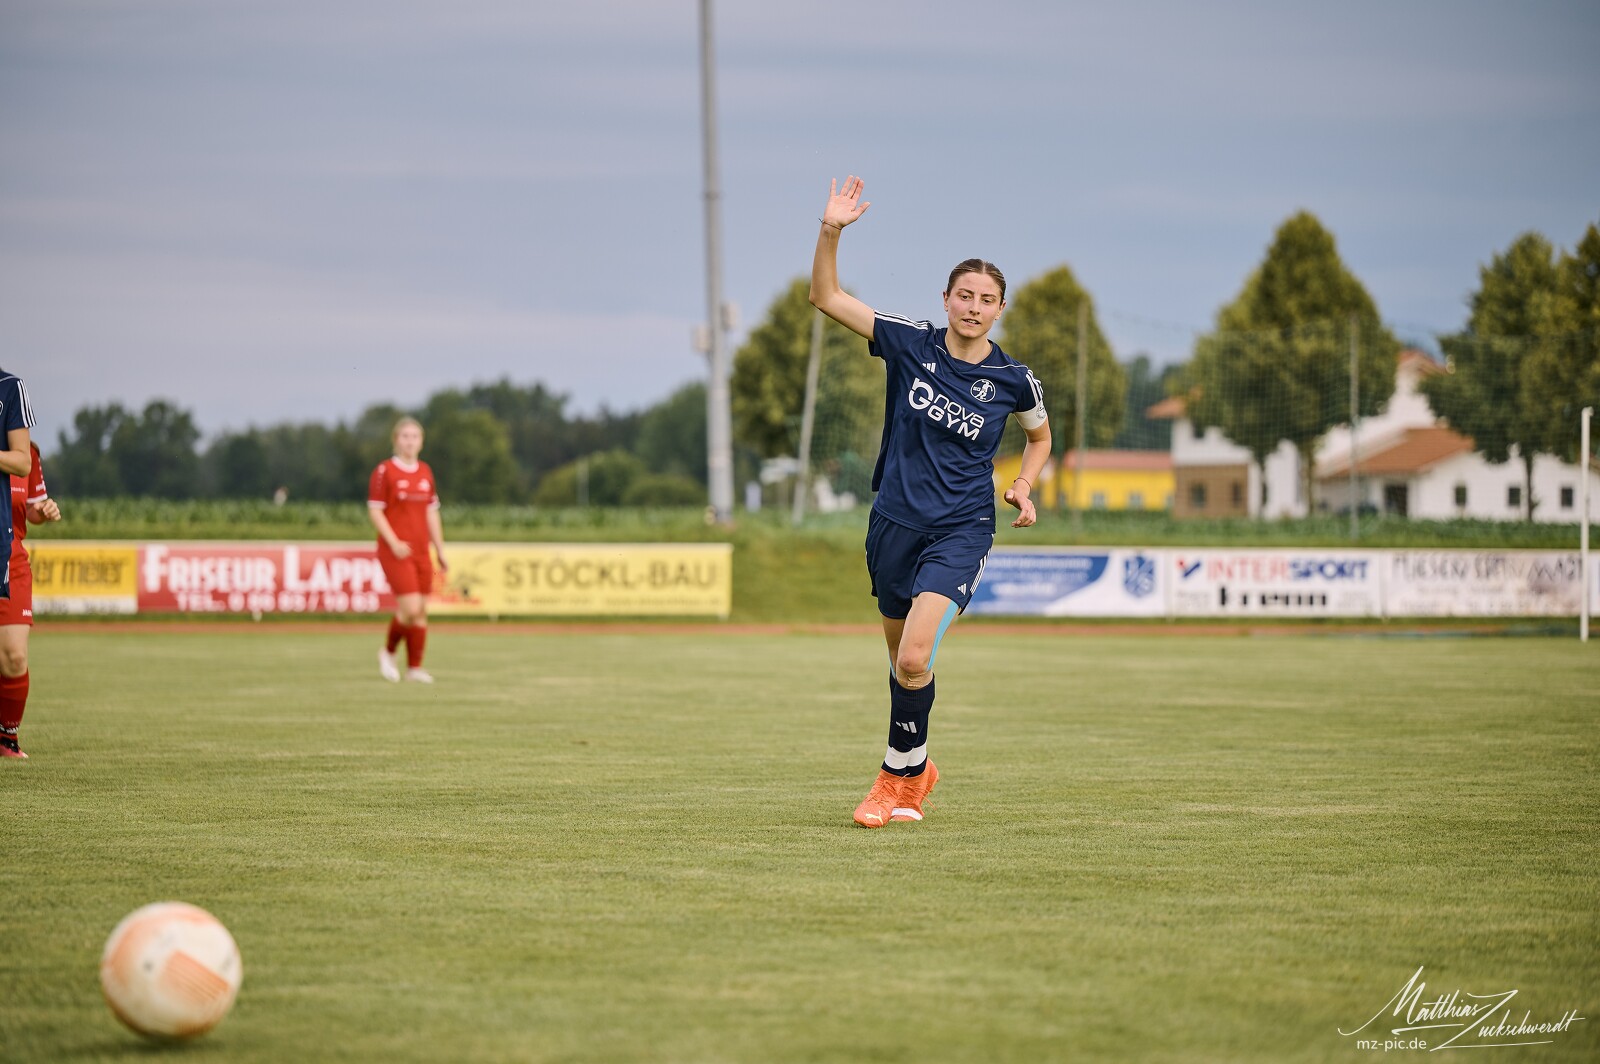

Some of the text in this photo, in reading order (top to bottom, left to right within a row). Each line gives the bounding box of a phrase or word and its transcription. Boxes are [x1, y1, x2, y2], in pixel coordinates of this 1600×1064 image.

[927, 404, 980, 441] GYM
[933, 393, 985, 428] nova
[142, 544, 277, 593] FRISEUR
[1206, 557, 1368, 580] INTERSPORT
